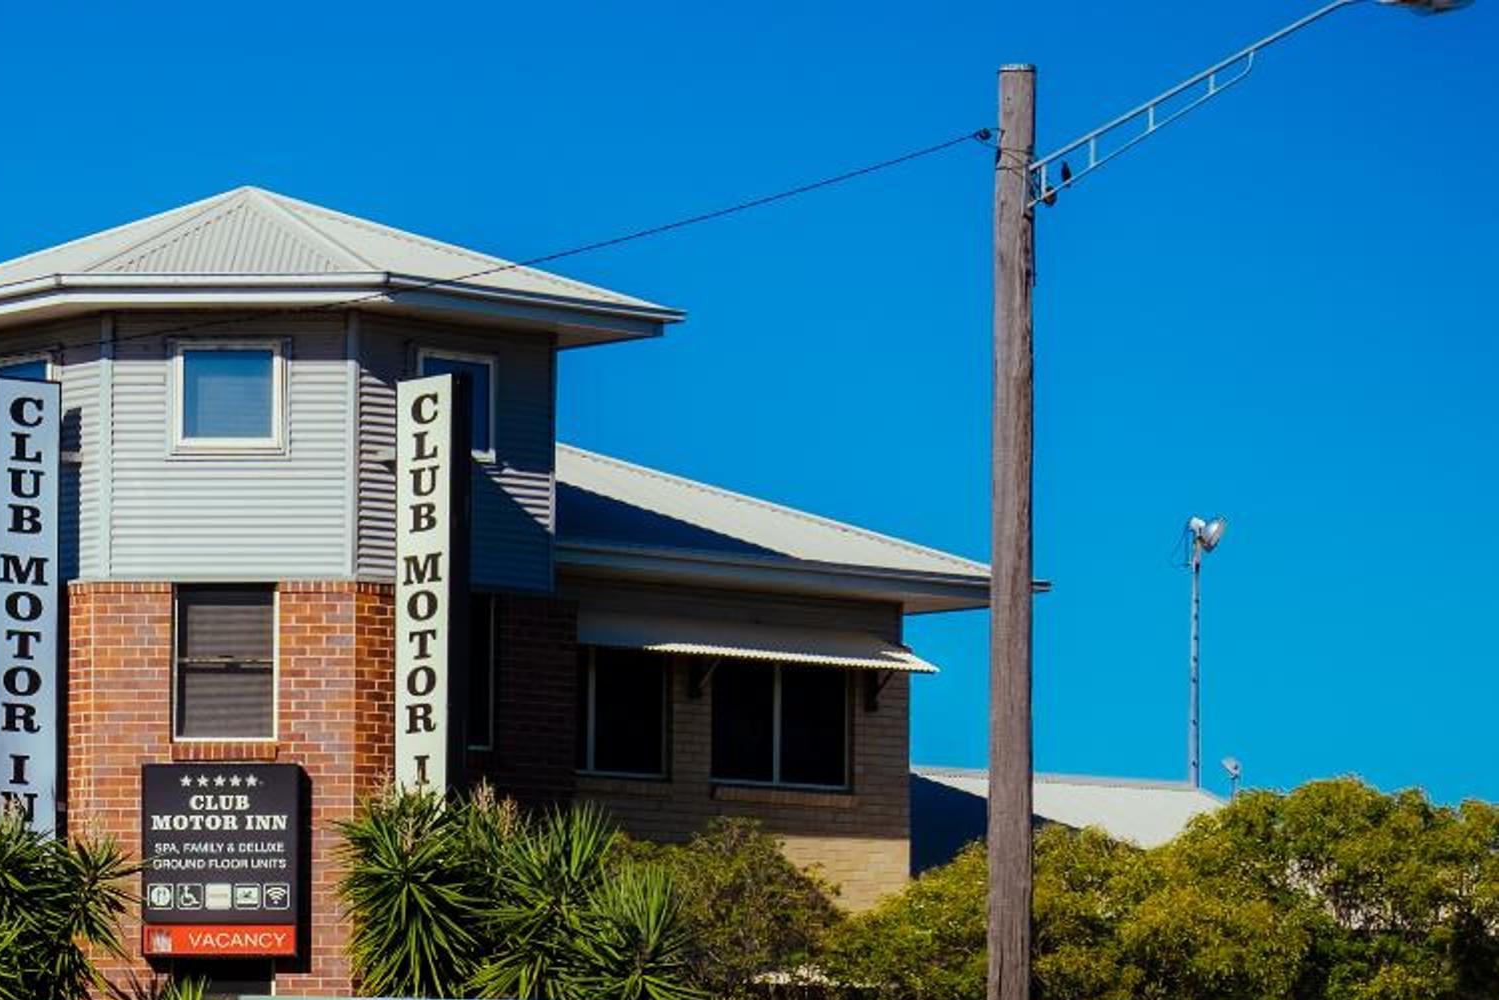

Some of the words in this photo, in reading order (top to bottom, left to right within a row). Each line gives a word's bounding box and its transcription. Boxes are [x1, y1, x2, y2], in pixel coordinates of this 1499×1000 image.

[7, 396, 45, 535] CLUB
[409, 392, 440, 533] CLUB
[402, 552, 444, 734] MOTOR
[189, 794, 251, 811] CLUB
[151, 814, 238, 831] MOTOR
[245, 814, 288, 830] INN
[154, 842, 180, 855] SPA,
[183, 842, 224, 853] FAMILY
[153, 858, 206, 870] GROUND
[208, 858, 248, 869] FLOOR
[250, 858, 287, 869] UNITS
[188, 932, 286, 948] VACANCY
